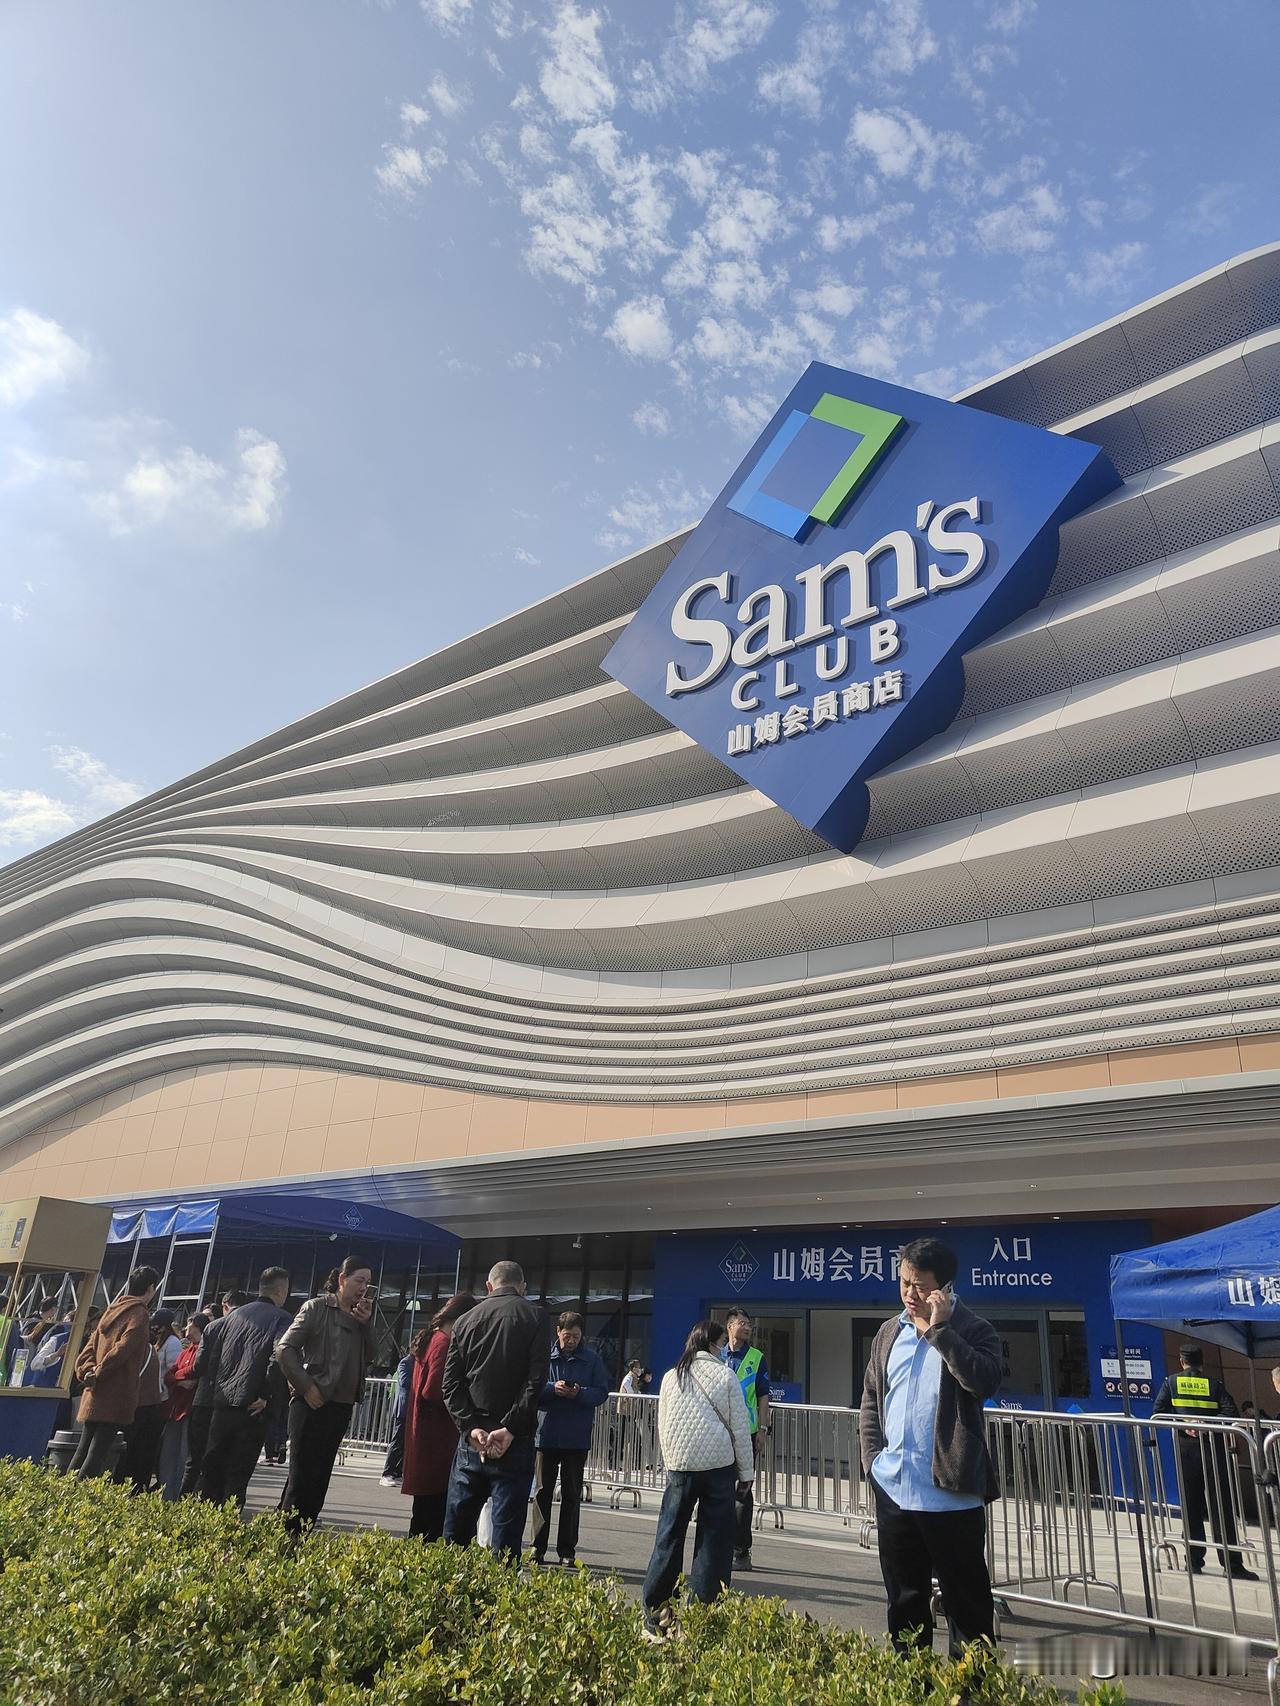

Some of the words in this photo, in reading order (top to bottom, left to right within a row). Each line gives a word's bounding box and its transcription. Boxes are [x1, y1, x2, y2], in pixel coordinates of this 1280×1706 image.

[665, 496, 987, 697] Sam's
[730, 619, 901, 711] CLUB
[727, 669, 905, 756] 山姆会员商店
[725, 1259, 753, 1273] Sam's
[971, 1267, 1053, 1286] Entrance
[989, 1237, 1032, 1263] 入口
